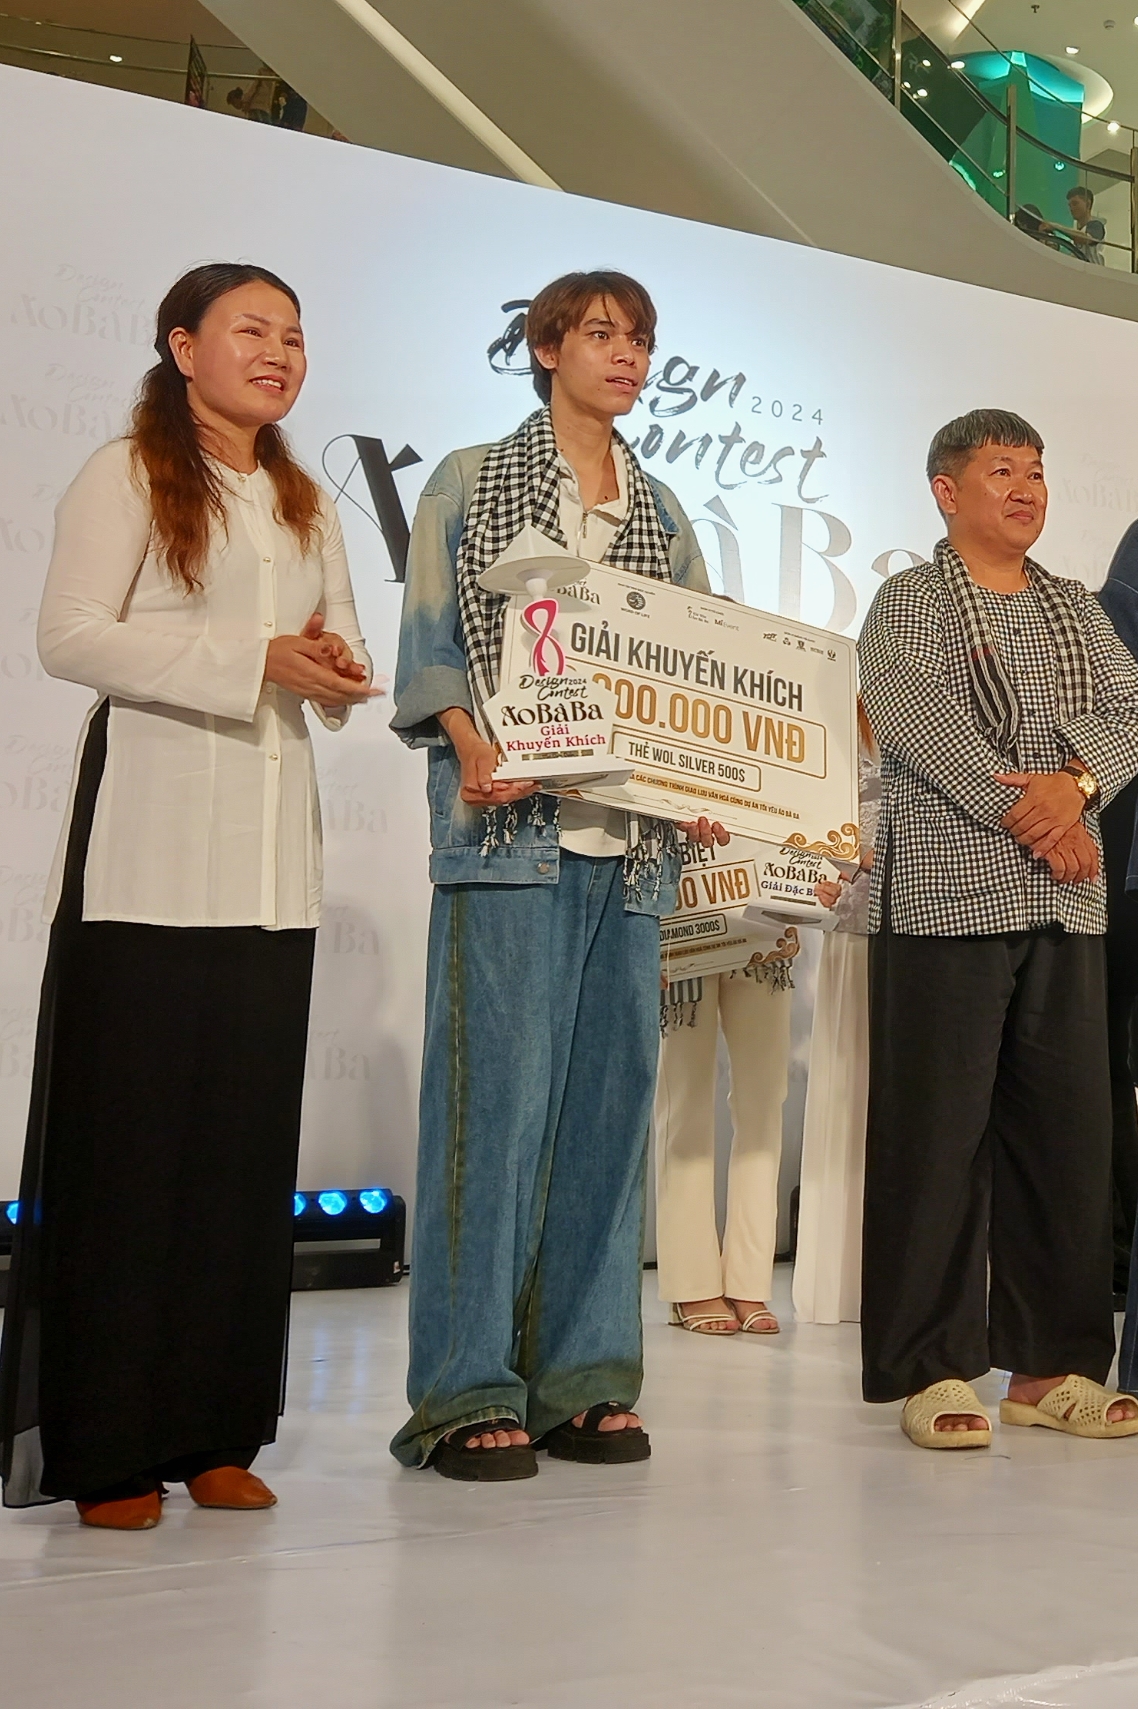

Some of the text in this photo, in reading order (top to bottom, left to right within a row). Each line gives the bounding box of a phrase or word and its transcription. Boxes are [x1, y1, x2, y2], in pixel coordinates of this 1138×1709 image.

[750, 394, 825, 427] 2024
[570, 620, 804, 713] GIẢI KHUYẾN KHÍCH
[518, 674, 568, 690] Design
[537, 686, 588, 701] Contest
[540, 723, 570, 736] Giải
[742, 709, 806, 765] VNĐ
[506, 734, 607, 752] Khuyến Khích
[628, 739, 746, 784] THẺ WOL SILVER 500$
[701, 867, 751, 905] VNĐ
[760, 880, 783, 892] Giải
[784, 884, 805, 896] Đặc
[659, 919, 721, 942] DIAMOND 3000$
